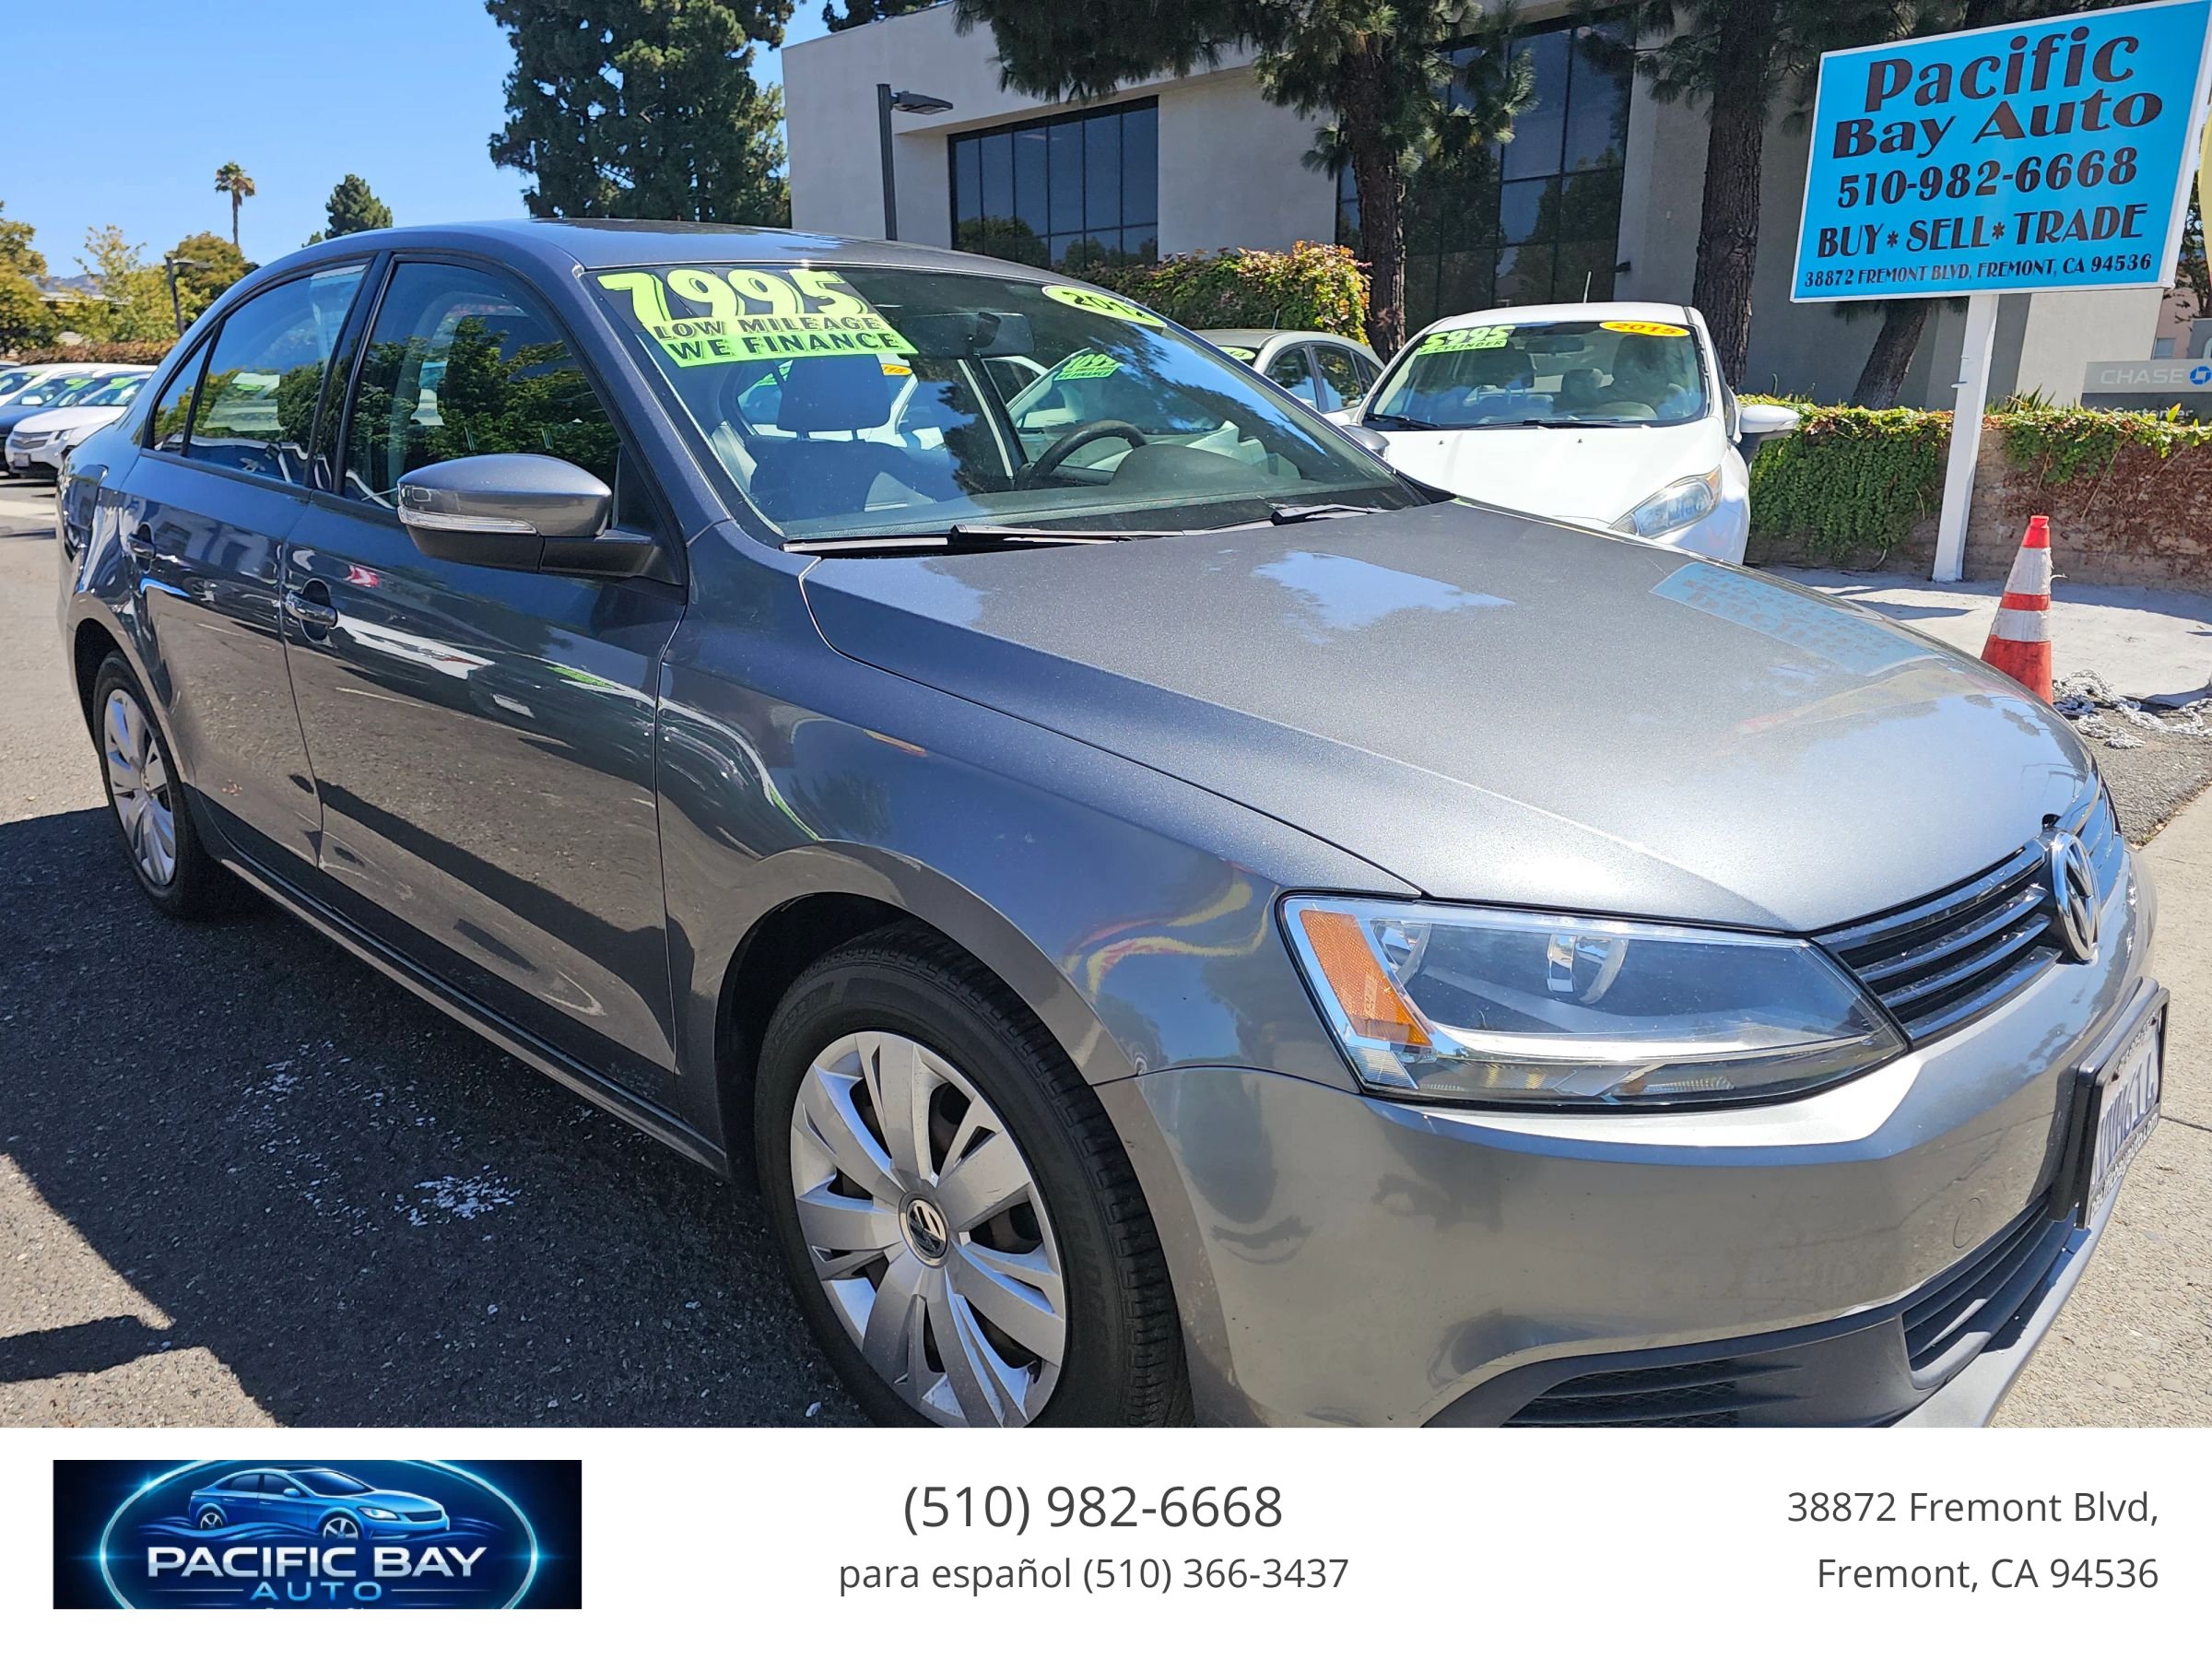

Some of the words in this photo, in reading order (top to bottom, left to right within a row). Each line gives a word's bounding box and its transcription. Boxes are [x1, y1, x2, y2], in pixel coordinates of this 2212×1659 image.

[1864, 26, 2139, 113] Pacific
[1832, 115, 1957, 159] Bay
[1971, 88, 2163, 144] Auto
[1837, 147, 2138, 208] 510-982-6668
[2013, 203, 2148, 245] TRADE
[1805, 268, 1854, 288] 38872
[1857, 265, 1927, 285] FREMONT
[1931, 264, 1972, 282] BLVD,
[1977, 258, 2057, 279] FREMONT,
[2062, 257, 2085, 275] CA
[2090, 253, 2152, 273] 94536
[596, 268, 869, 321] 7995
[653, 318, 725, 340] LOW
[737, 316, 882, 335] MILEAGE
[1423, 324, 1516, 347] 5995
[1610, 322, 1677, 335] 2015
[668, 337, 732, 360] WE
[742, 332, 901, 354] FINANCE
[2100, 368, 2186, 385] CHASE
